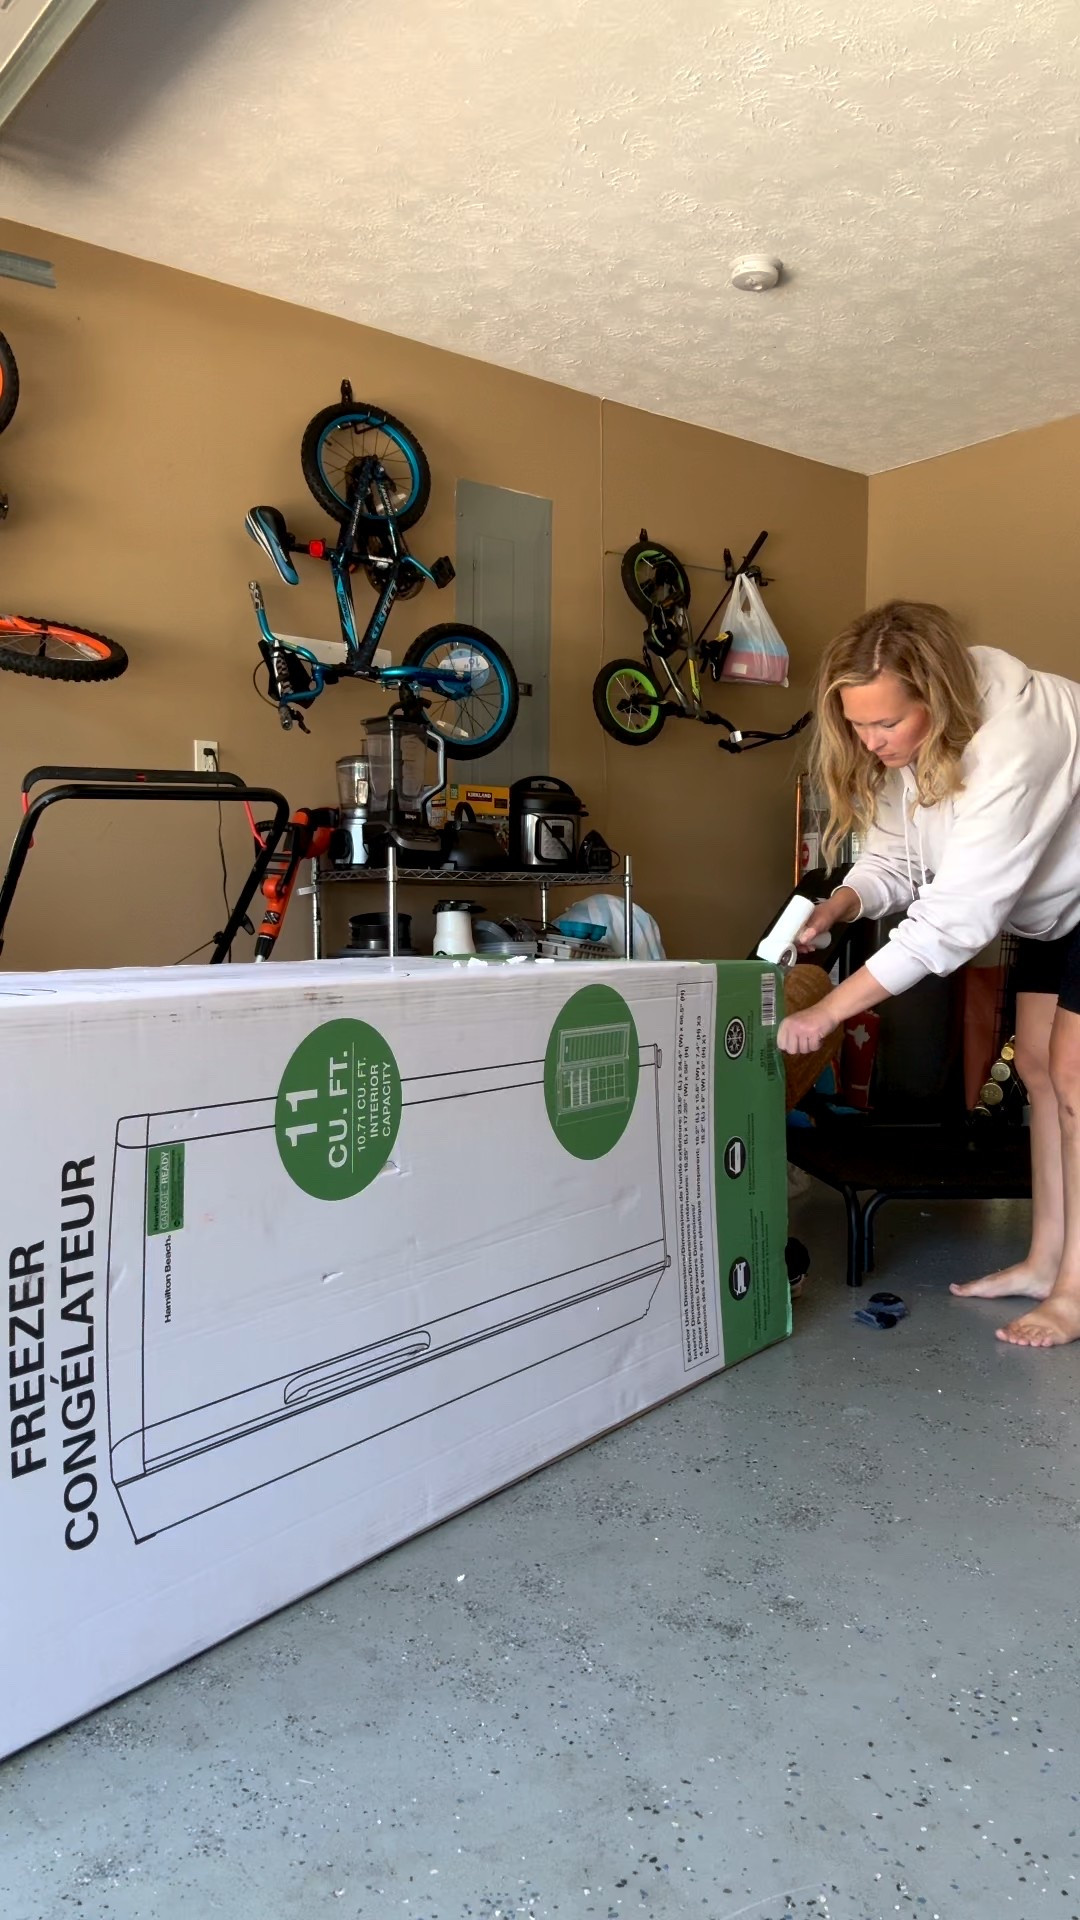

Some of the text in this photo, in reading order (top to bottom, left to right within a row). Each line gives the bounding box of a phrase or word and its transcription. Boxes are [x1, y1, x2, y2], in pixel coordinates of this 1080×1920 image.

[285, 1088, 318, 1147] 11
[328, 1050, 348, 1169] CU. FT.
[356, 1057, 367, 1153] 10.71 CU. FT.
[369, 1064, 379, 1138] INTERIOR
[382, 1061, 391, 1137] CAPACITY
[163, 1273, 172, 1324] Hamilton
[9, 1240, 46, 1480] FREEZER
[50, 1155, 98, 1552] CONGÉLATEUR
